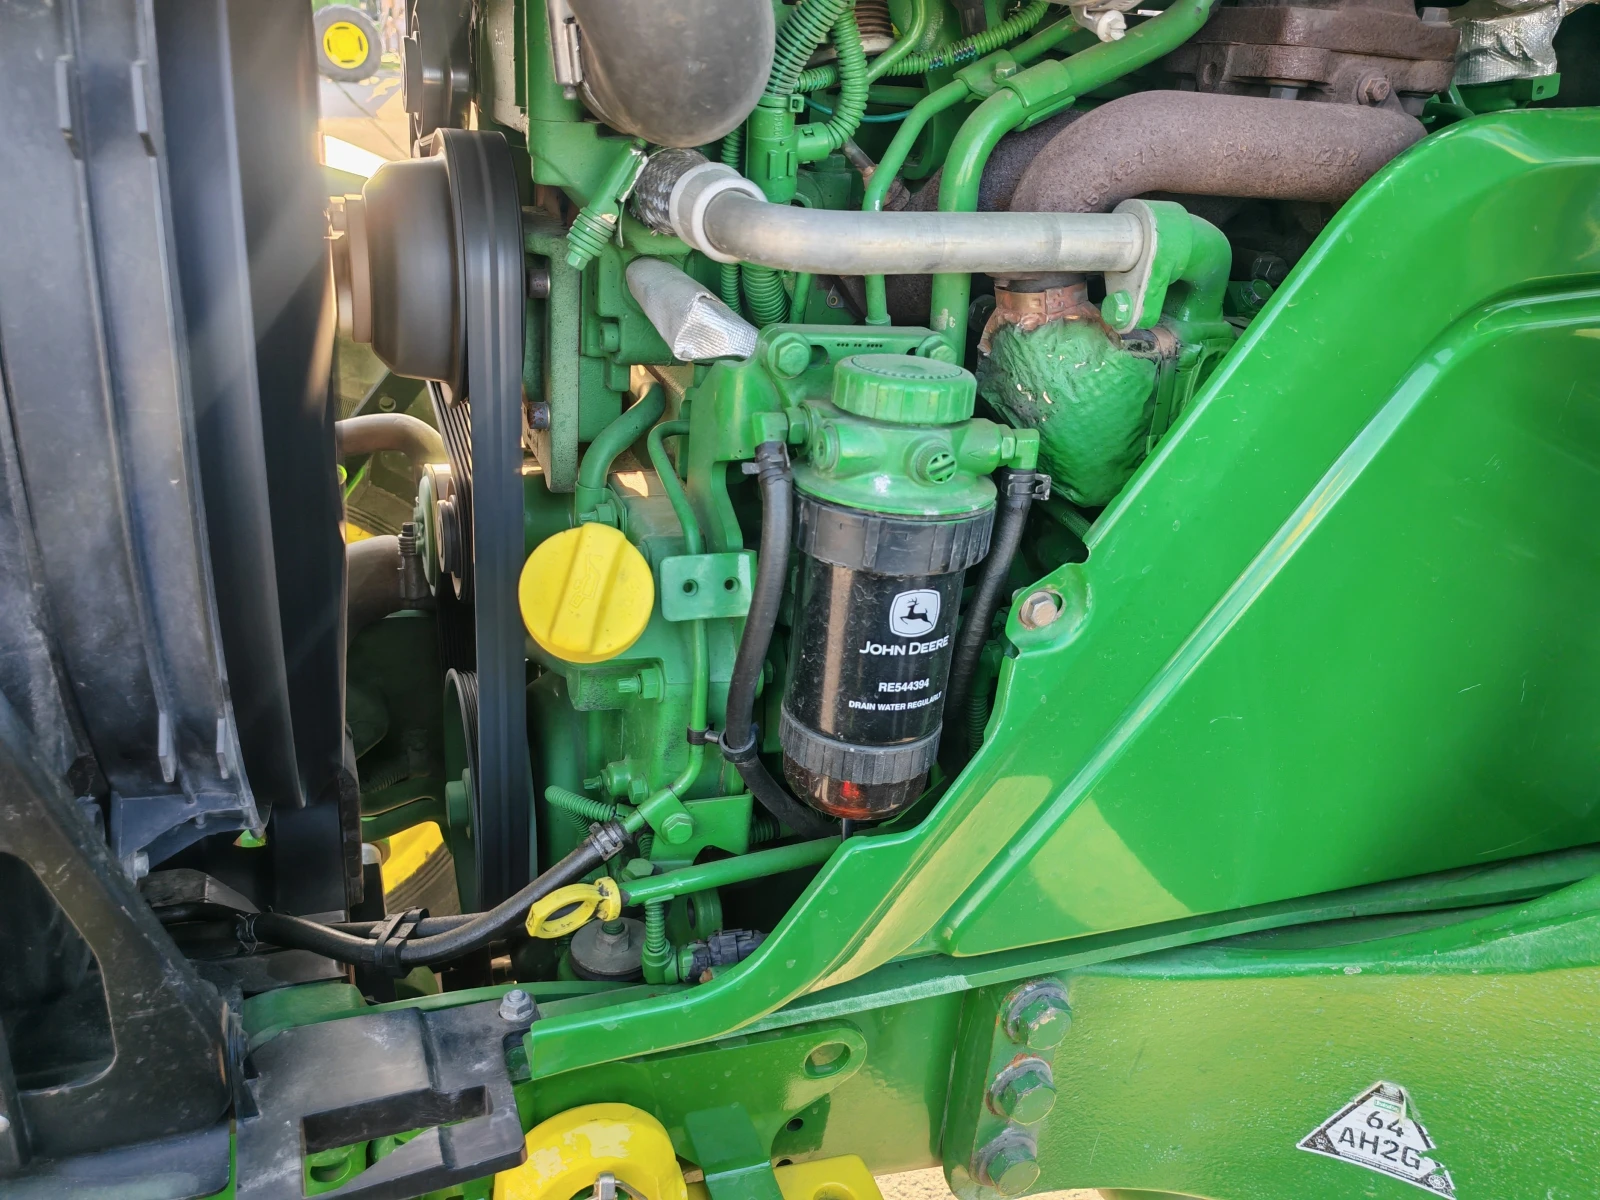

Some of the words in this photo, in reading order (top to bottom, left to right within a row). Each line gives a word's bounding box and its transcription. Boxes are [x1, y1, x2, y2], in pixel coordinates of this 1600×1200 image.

[859, 641, 906, 656] JOHN
[908, 635, 949, 655] DEERE
[878, 678, 930, 692] RE544394
[848, 700, 876, 711] DRAIN
[877, 702, 906, 711] WATER
[907, 691, 942, 709] REGULARLY
[1366, 1111, 1404, 1138] 64
[1338, 1127, 1421, 1171] AH2G
